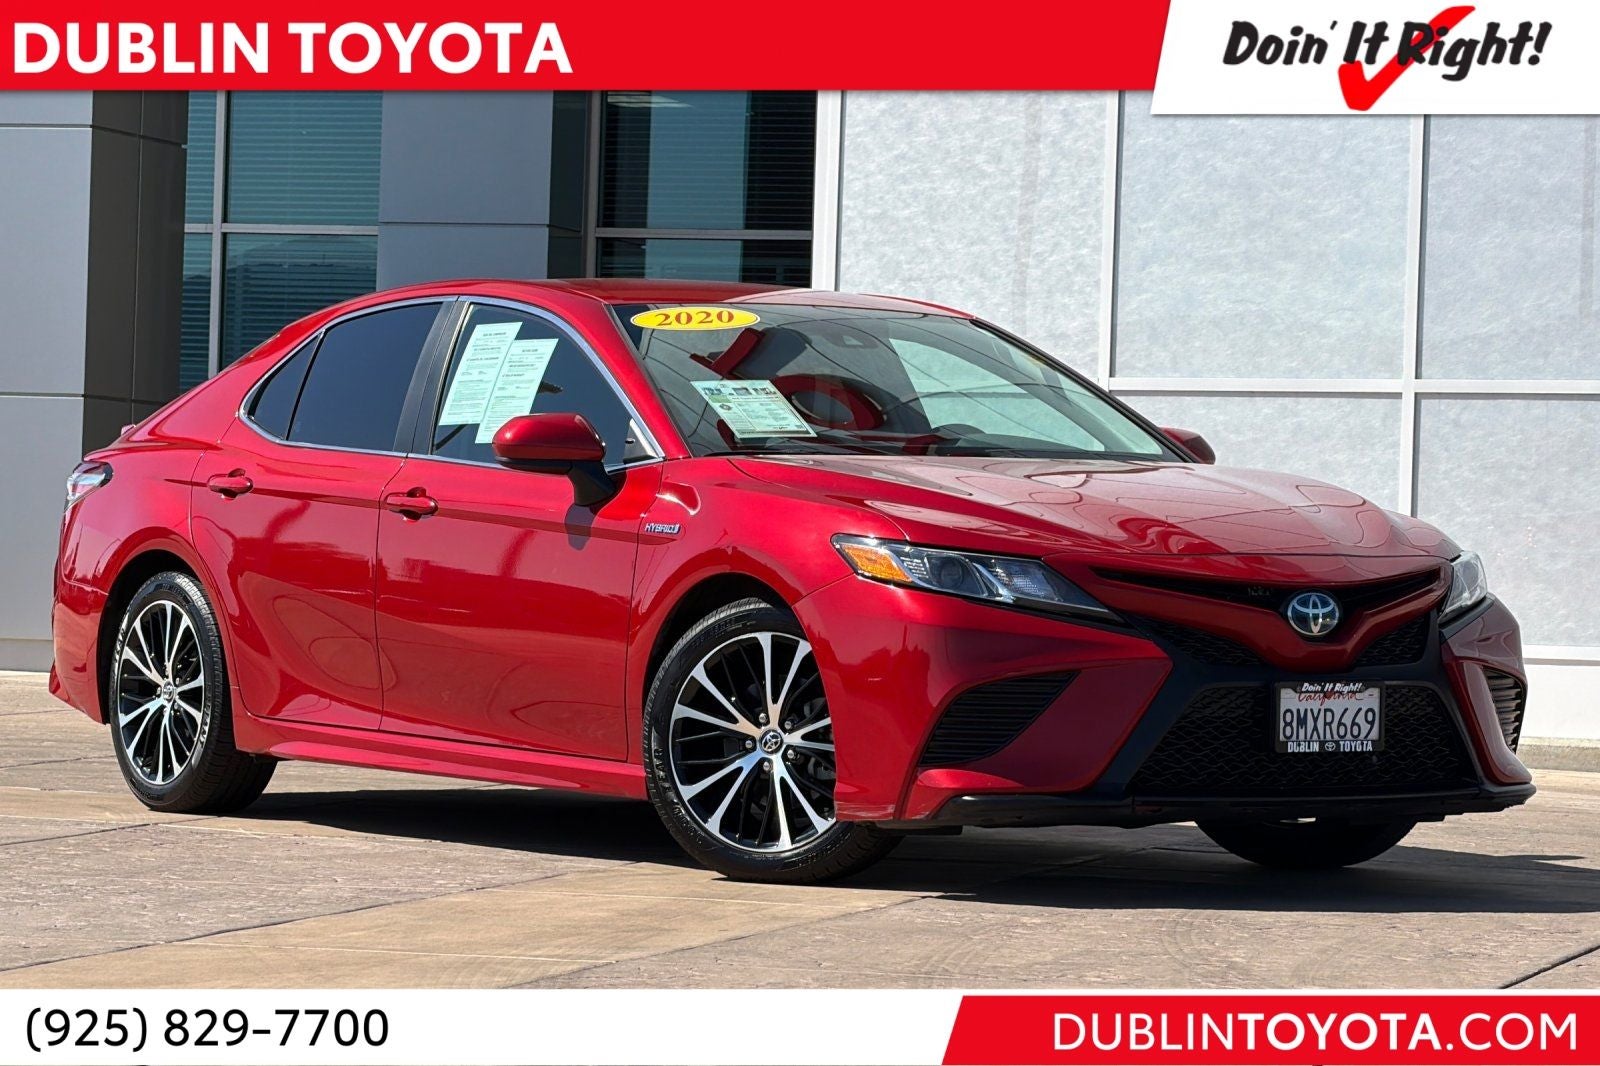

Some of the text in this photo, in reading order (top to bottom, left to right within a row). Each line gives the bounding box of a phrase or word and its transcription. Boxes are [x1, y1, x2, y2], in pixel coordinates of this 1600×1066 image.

[655, 310, 735, 327] 2020
[645, 522, 678, 534] HYBRID
[1324, 682, 1333, 692] It
[1334, 683, 1363, 693] Right!
[1282, 707, 1377, 740] 8MXR669
[1287, 741, 1373, 753] DUBLIN TOYOTA
